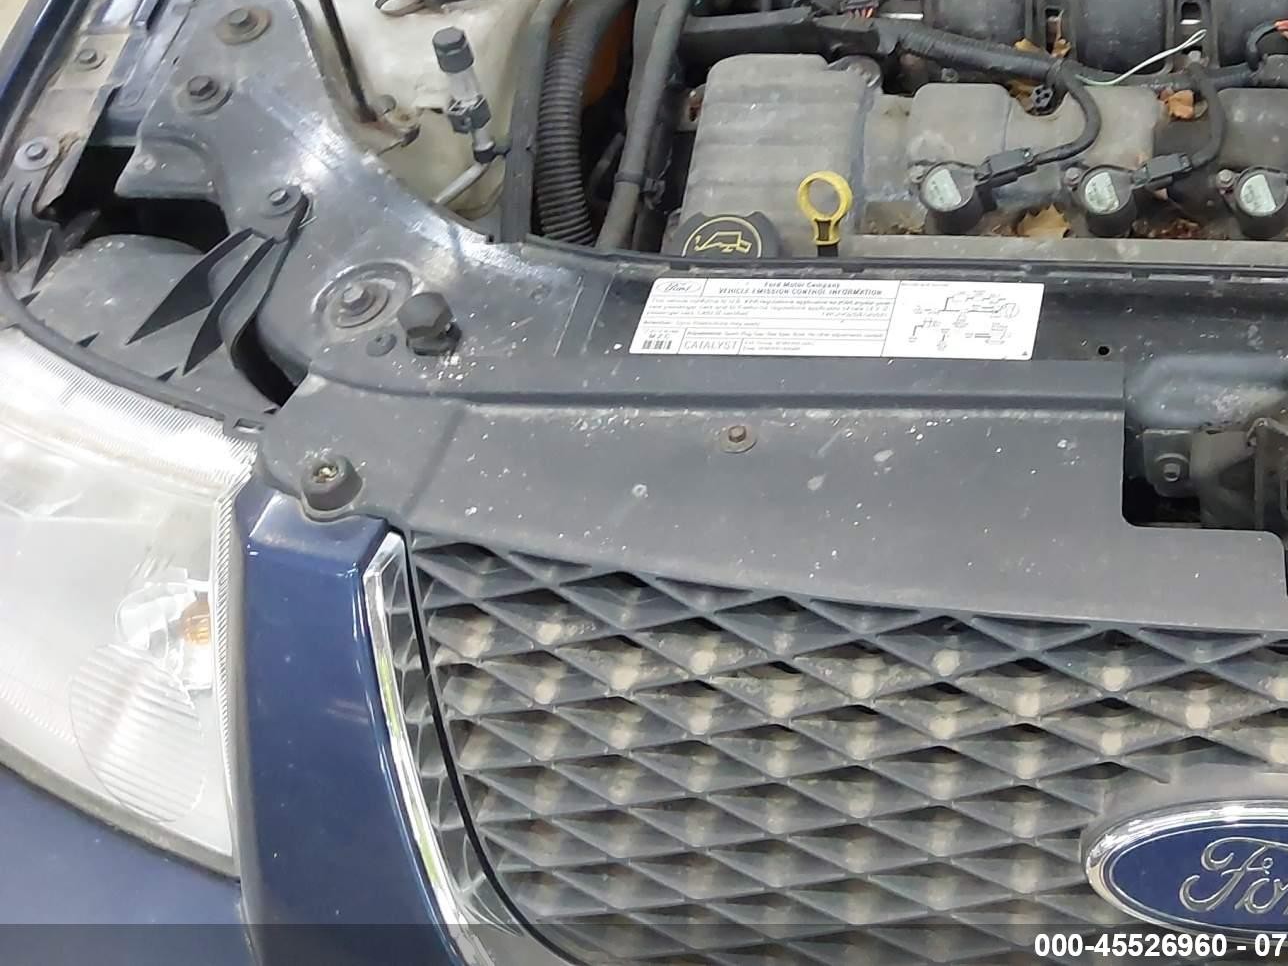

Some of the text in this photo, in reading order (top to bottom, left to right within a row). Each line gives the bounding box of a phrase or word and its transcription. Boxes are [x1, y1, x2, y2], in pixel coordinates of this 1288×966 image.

[807, 281, 840, 290] Company
[719, 287, 883, 296] VEHICLE EMISSION CONTROL INFORMATION
[684, 340, 738, 350] CATALYST
